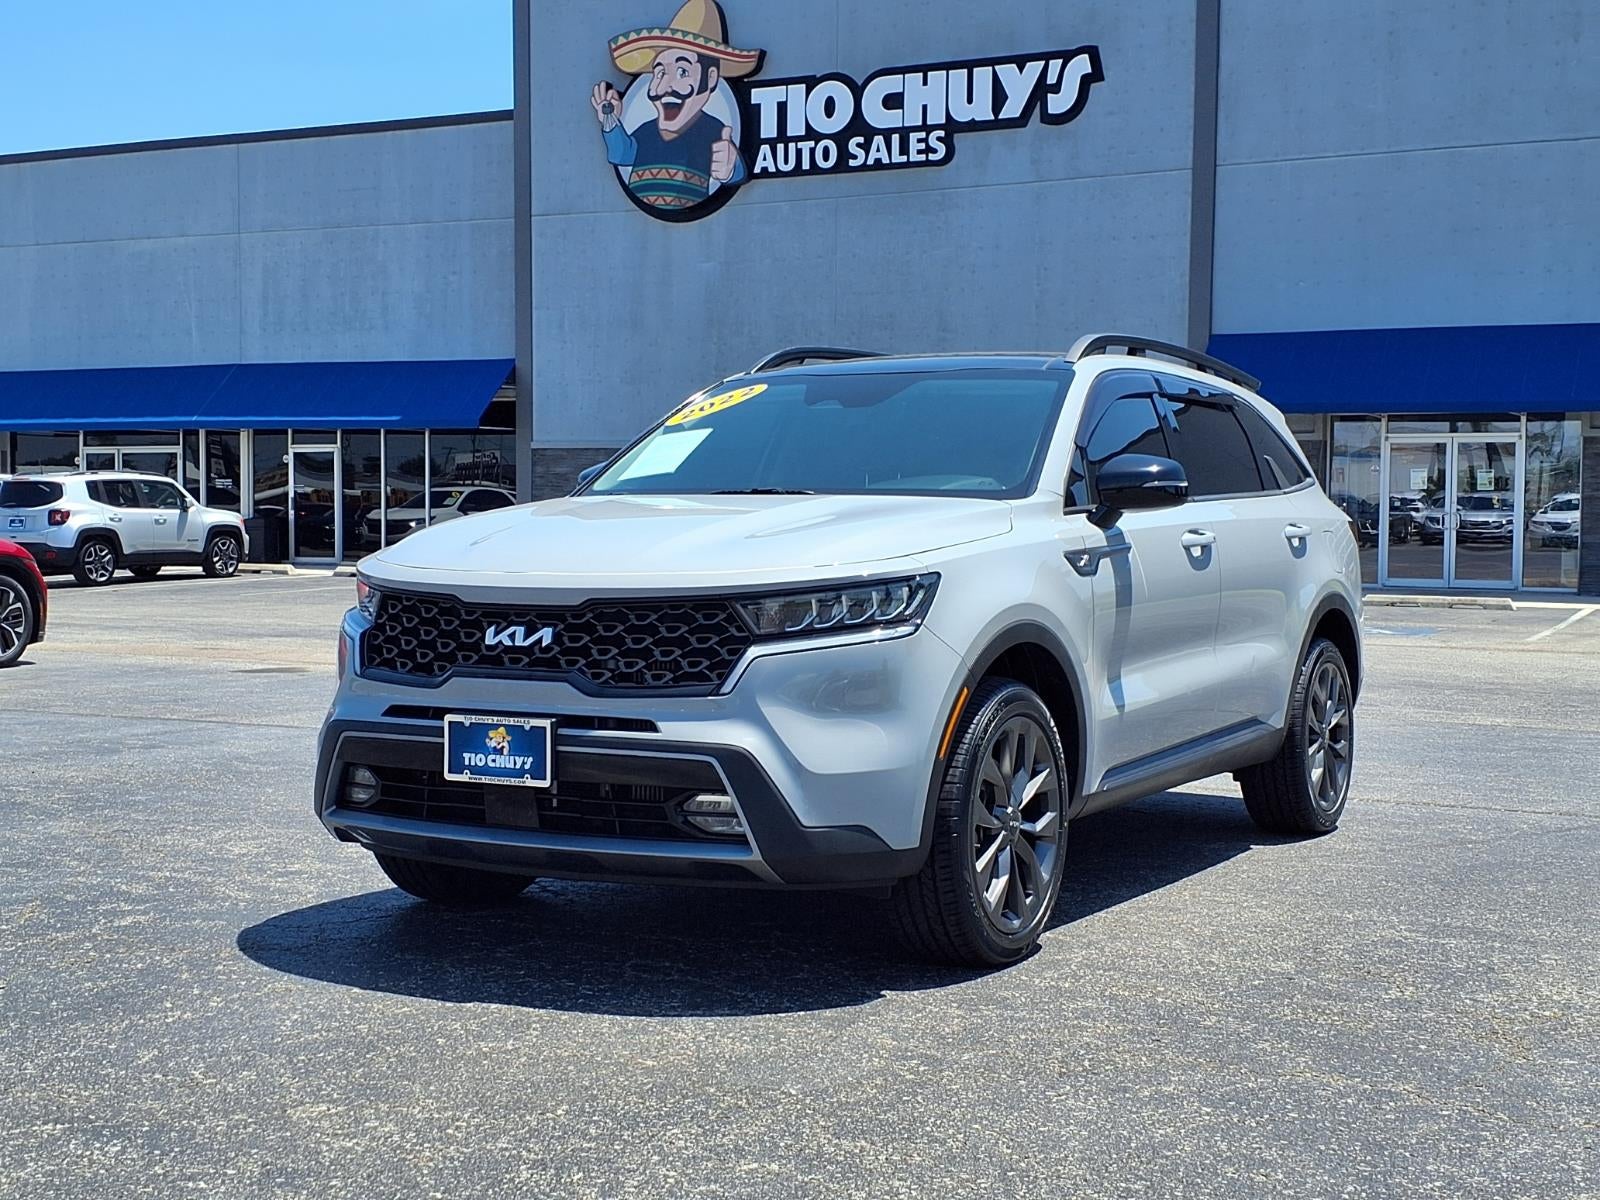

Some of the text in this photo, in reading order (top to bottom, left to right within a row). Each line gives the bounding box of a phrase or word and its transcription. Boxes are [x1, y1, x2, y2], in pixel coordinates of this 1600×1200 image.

[751, 54, 1091, 137] TIO CHUY'S
[753, 130, 946, 174] AUTO SALES
[680, 387, 756, 421] 2022
[485, 624, 552, 647] KIA
[463, 753, 533, 769] TIO CHUY'S
